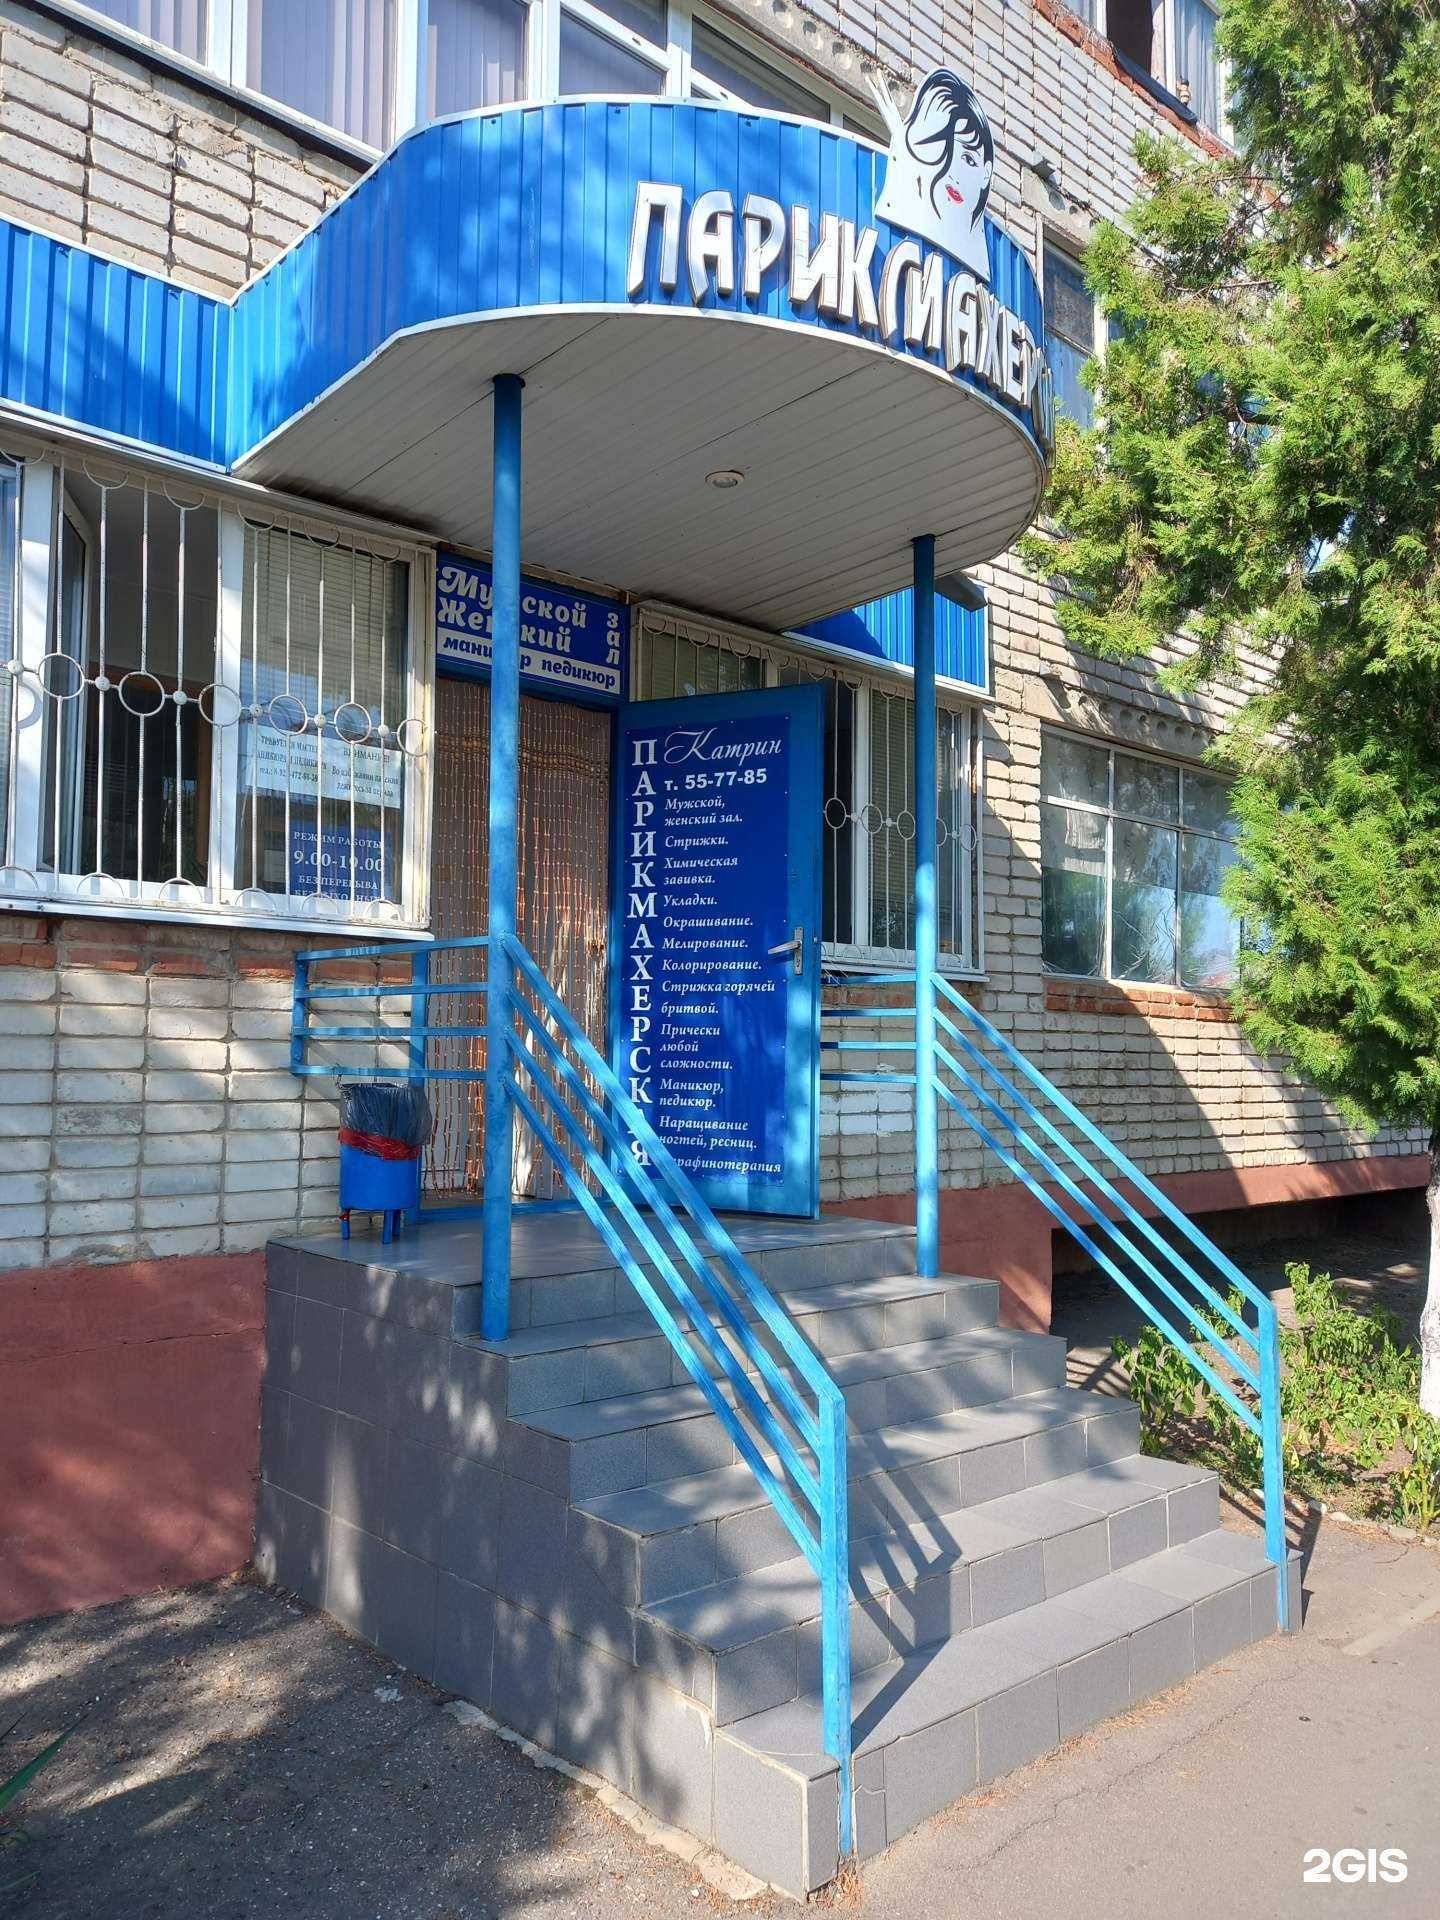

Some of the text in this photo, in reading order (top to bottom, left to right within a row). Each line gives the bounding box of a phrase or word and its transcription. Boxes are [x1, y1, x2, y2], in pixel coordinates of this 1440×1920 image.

[438, 566, 587, 628] Муской
[437, 597, 572, 652] Жекий
[606, 612, 620, 665] зал
[443, 636, 531, 670] манир
[541, 658, 616, 689] педикюр
[664, 727, 782, 766] Катрин
[664, 768, 767, 791] т. 55-77-85
[665, 796, 725, 813] Мужской,
[664, 813, 743, 826] женский зал.
[665, 835, 728, 850] Стрижки.
[664, 857, 738, 869] Химическая
[664, 874, 715, 885] завивка.
[663, 894, 718, 907] Укладки.
[663, 916, 753, 931] Окрашивание.
[627, 739, 658, 1166] ПАРИКМАХЕРСКЯ
[662, 937, 748, 952] Мелирование.
[662, 959, 762, 974] Колорирование.
[662, 980, 775, 995] Стрижка горячей
[661, 1001, 719, 1017] бритвой.
[660, 1023, 720, 1038] Прически
[660, 1040, 699, 1052] любой
[660, 1059, 733, 1069] сложности.
[659, 1078, 724, 1094] Маникюр,
[659, 1094, 716, 1110] педикюр.
[659, 1115, 748, 1133] Наращивание
[659, 1134, 757, 1152] ногтей, ресниц.
[673, 1156, 781, 1174] рафинотерапия
